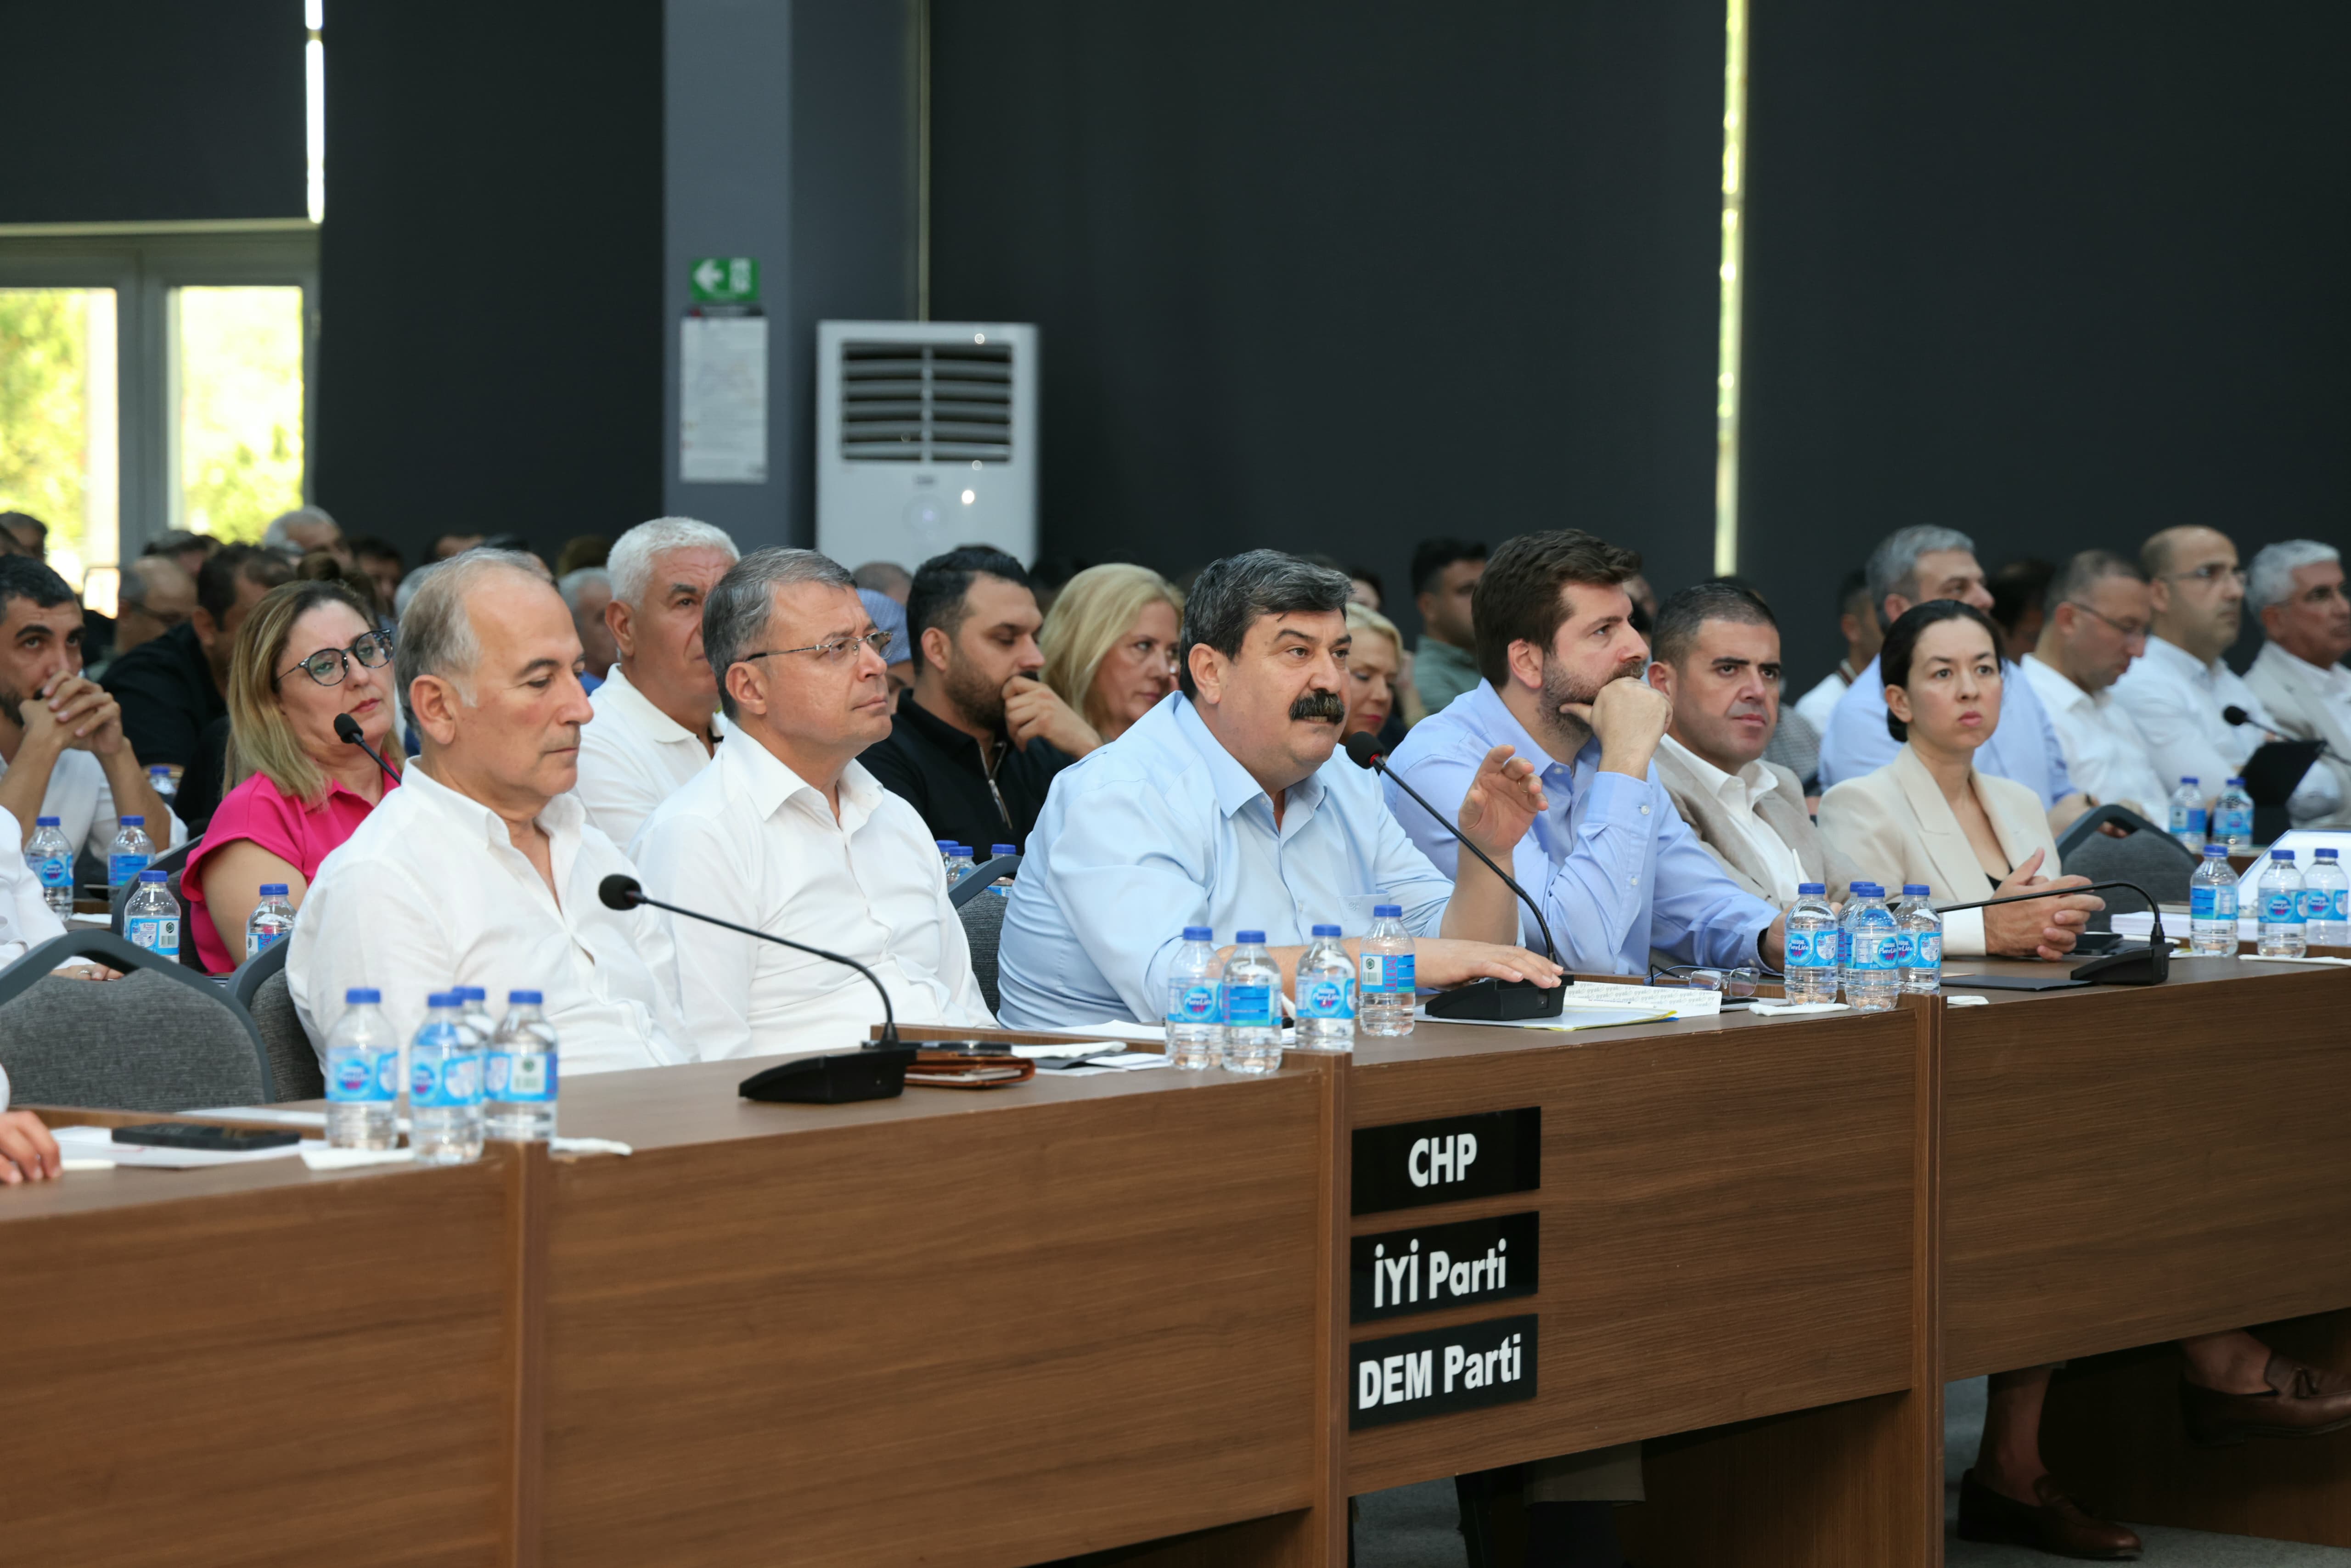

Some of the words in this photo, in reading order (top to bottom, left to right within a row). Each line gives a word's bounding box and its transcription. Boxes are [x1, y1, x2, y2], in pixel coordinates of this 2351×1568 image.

[1408, 1133, 1477, 1187] CHP
[1374, 1239, 1418, 1308] İYİ
[1429, 1238, 1506, 1299] Parti
[1359, 1349, 1432, 1410] DEM
[1444, 1333, 1521, 1393] Parti
